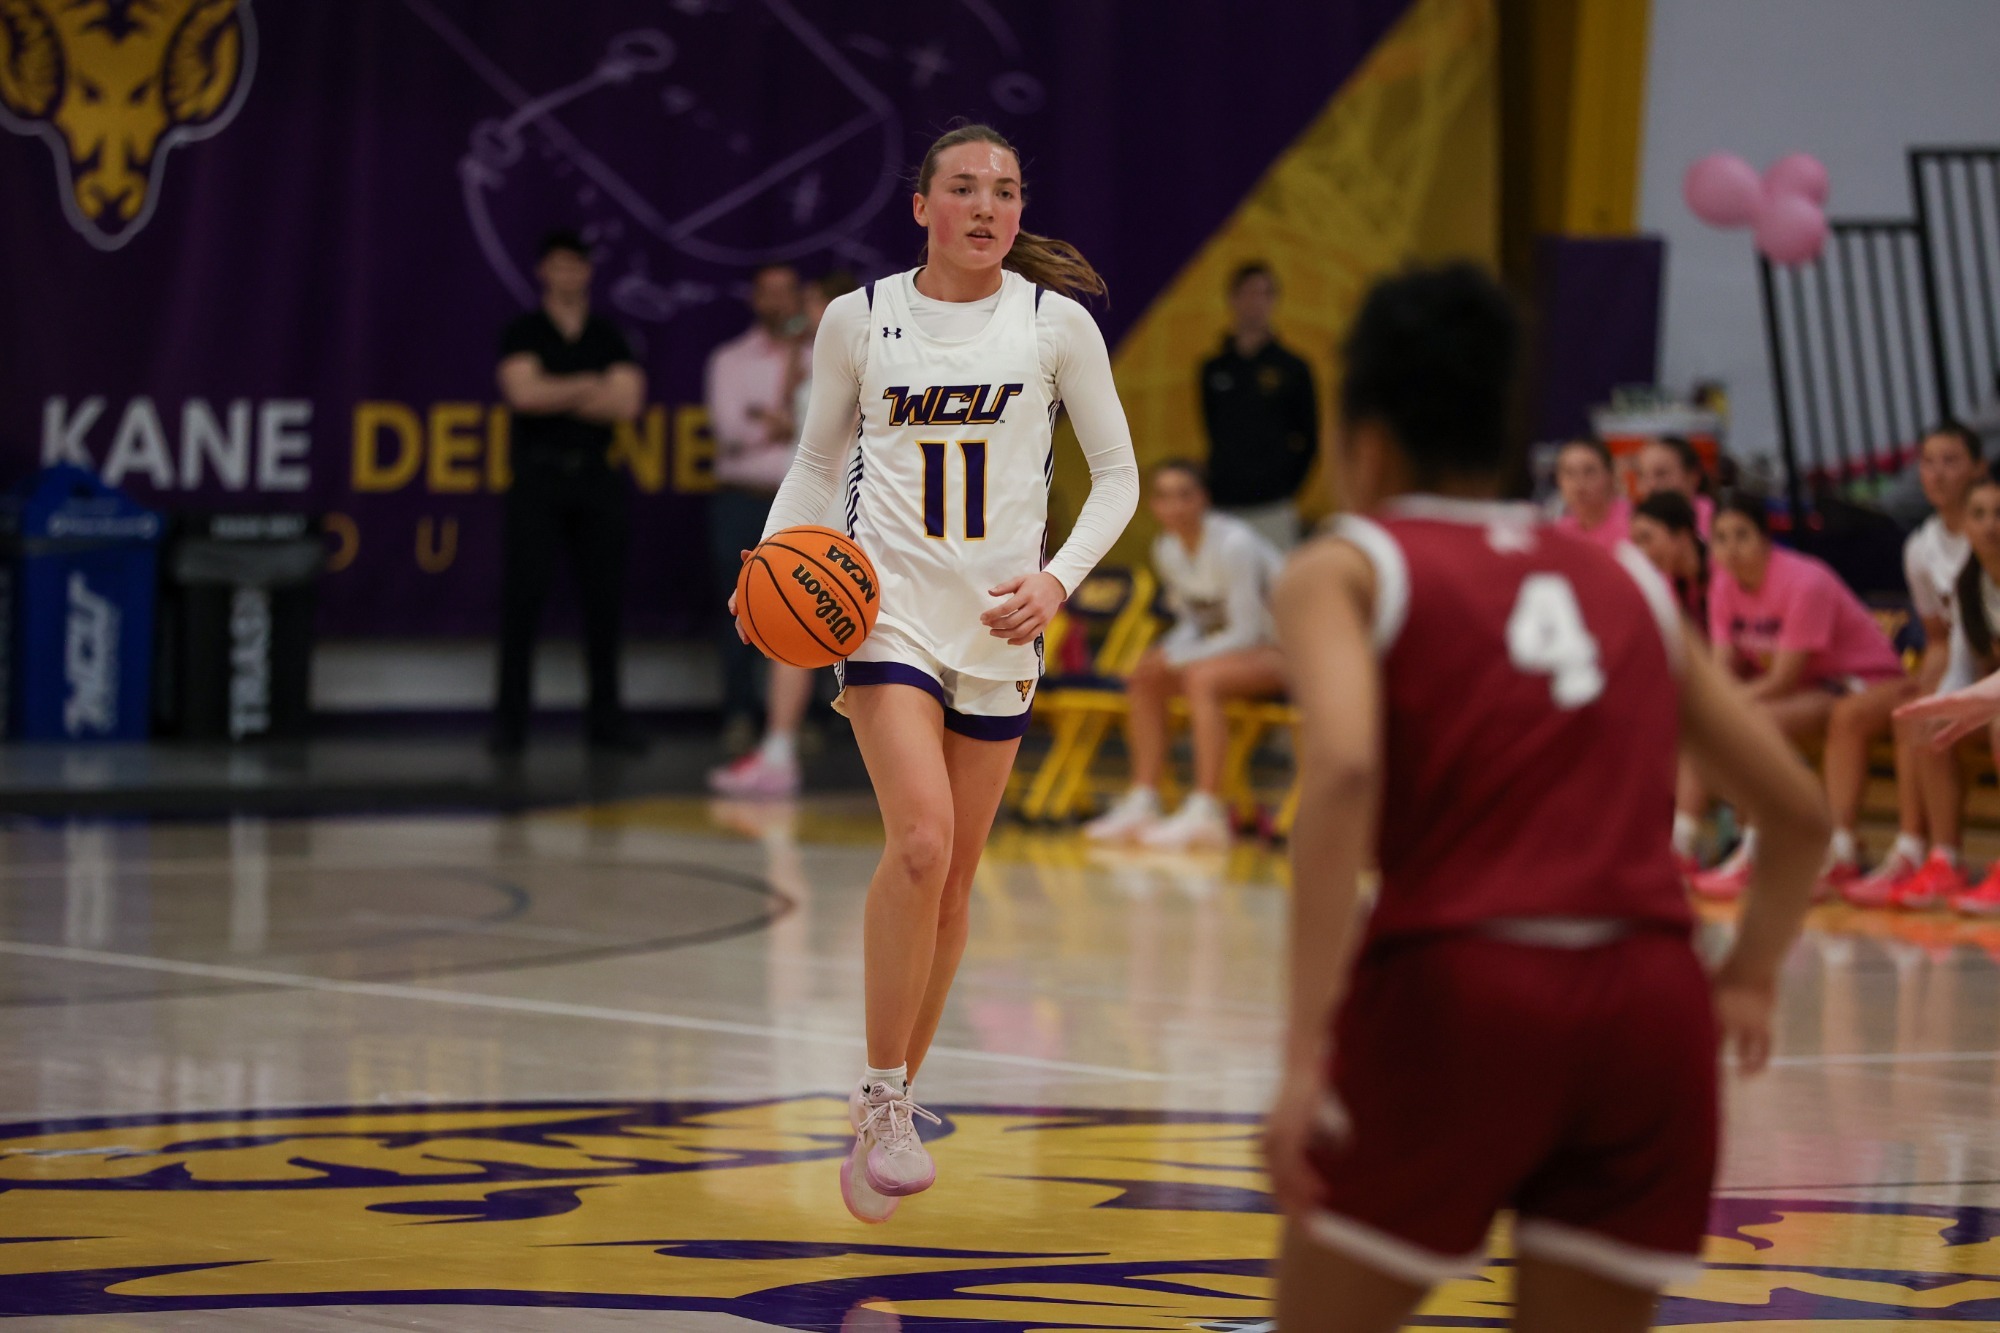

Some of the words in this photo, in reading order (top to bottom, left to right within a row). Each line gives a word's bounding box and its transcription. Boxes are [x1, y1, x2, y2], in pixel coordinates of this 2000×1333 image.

[40, 395, 313, 492] KANE
[882, 383, 1024, 427] WCU
[914, 439, 989, 542] 11
[792, 563, 856, 645] Wilson
[825, 544, 876, 604] NCAA
[1506, 571, 1605, 709] 4
